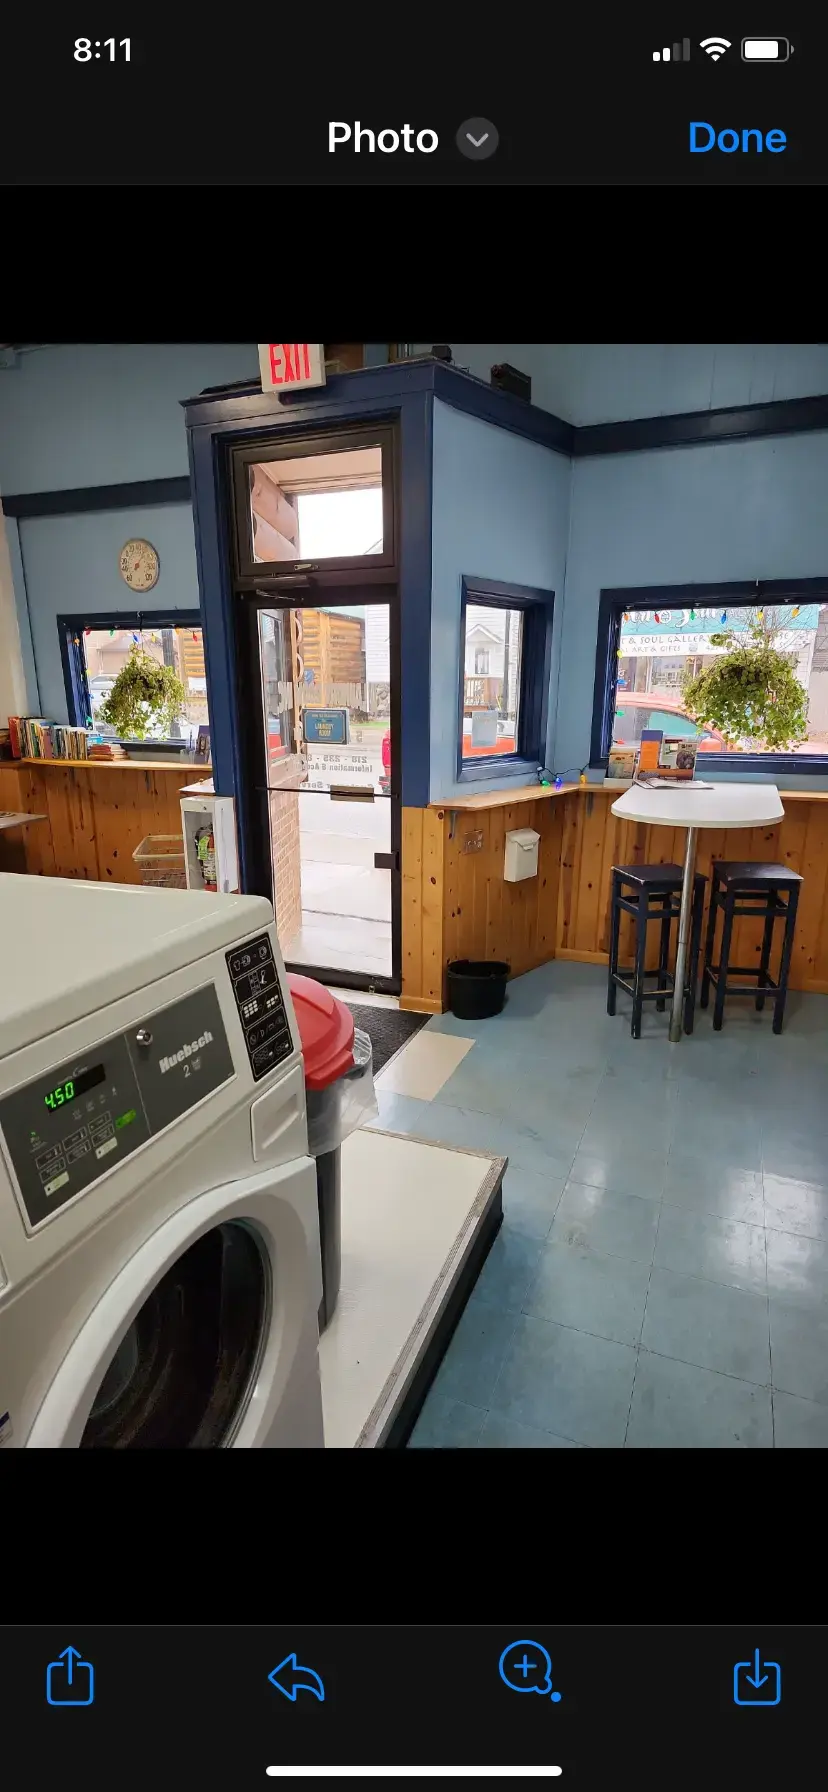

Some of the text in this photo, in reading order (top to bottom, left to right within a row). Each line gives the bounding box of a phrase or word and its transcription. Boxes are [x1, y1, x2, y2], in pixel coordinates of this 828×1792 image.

[640, 636, 664, 644] SOUL
[158, 1030, 214, 1074] Huebsch
[183, 1064, 191, 1078] 2
[44, 1081, 75, 1109] 4.50
